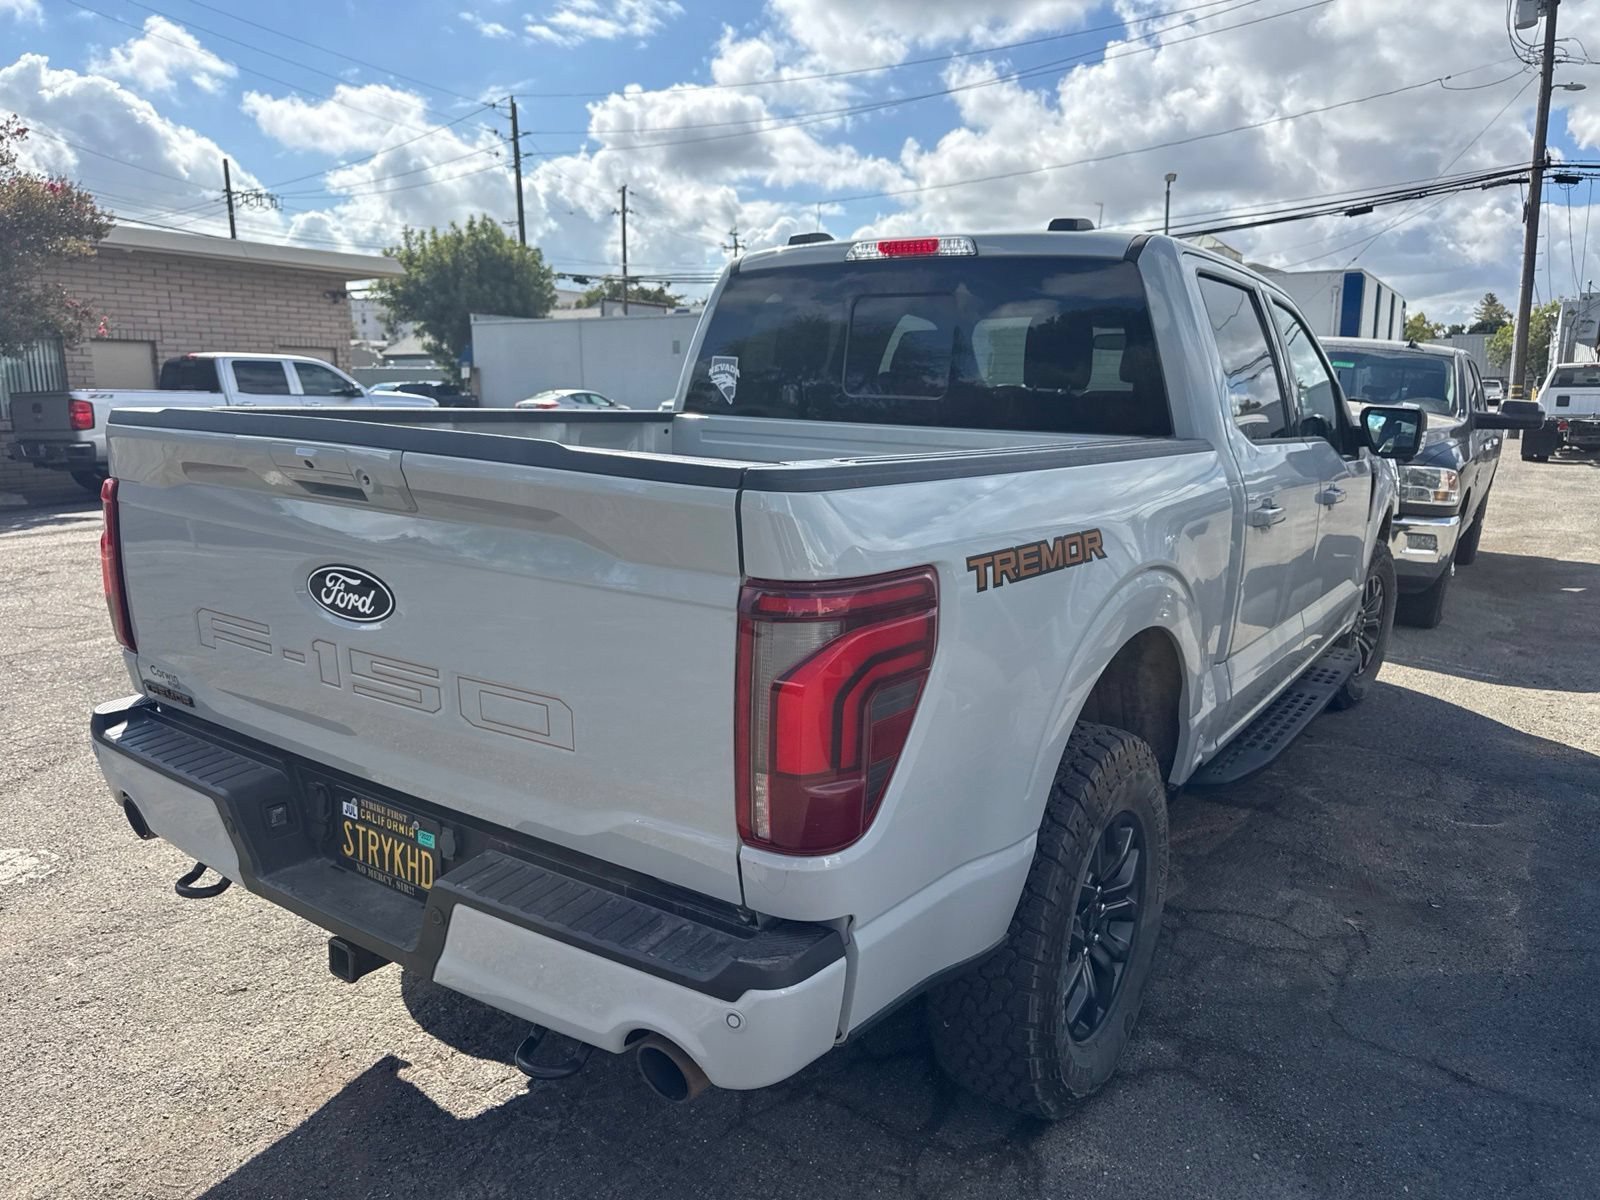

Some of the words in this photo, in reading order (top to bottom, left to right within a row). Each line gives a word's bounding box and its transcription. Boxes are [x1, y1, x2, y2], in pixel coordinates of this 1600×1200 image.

[709, 363, 740, 378] NEVADA
[966, 528, 1108, 593] TREMOR
[321, 572, 375, 614] Ford
[196, 608, 575, 752] F-150
[344, 804, 357, 818] JUL
[360, 799, 386, 815] STRIKE
[387, 807, 407, 823] FIRST
[360, 808, 415, 839] CALIFORNIA
[343, 820, 434, 890] STRYKHD
[356, 863, 366, 875] NO
[396, 881, 415, 896] SIR!!
